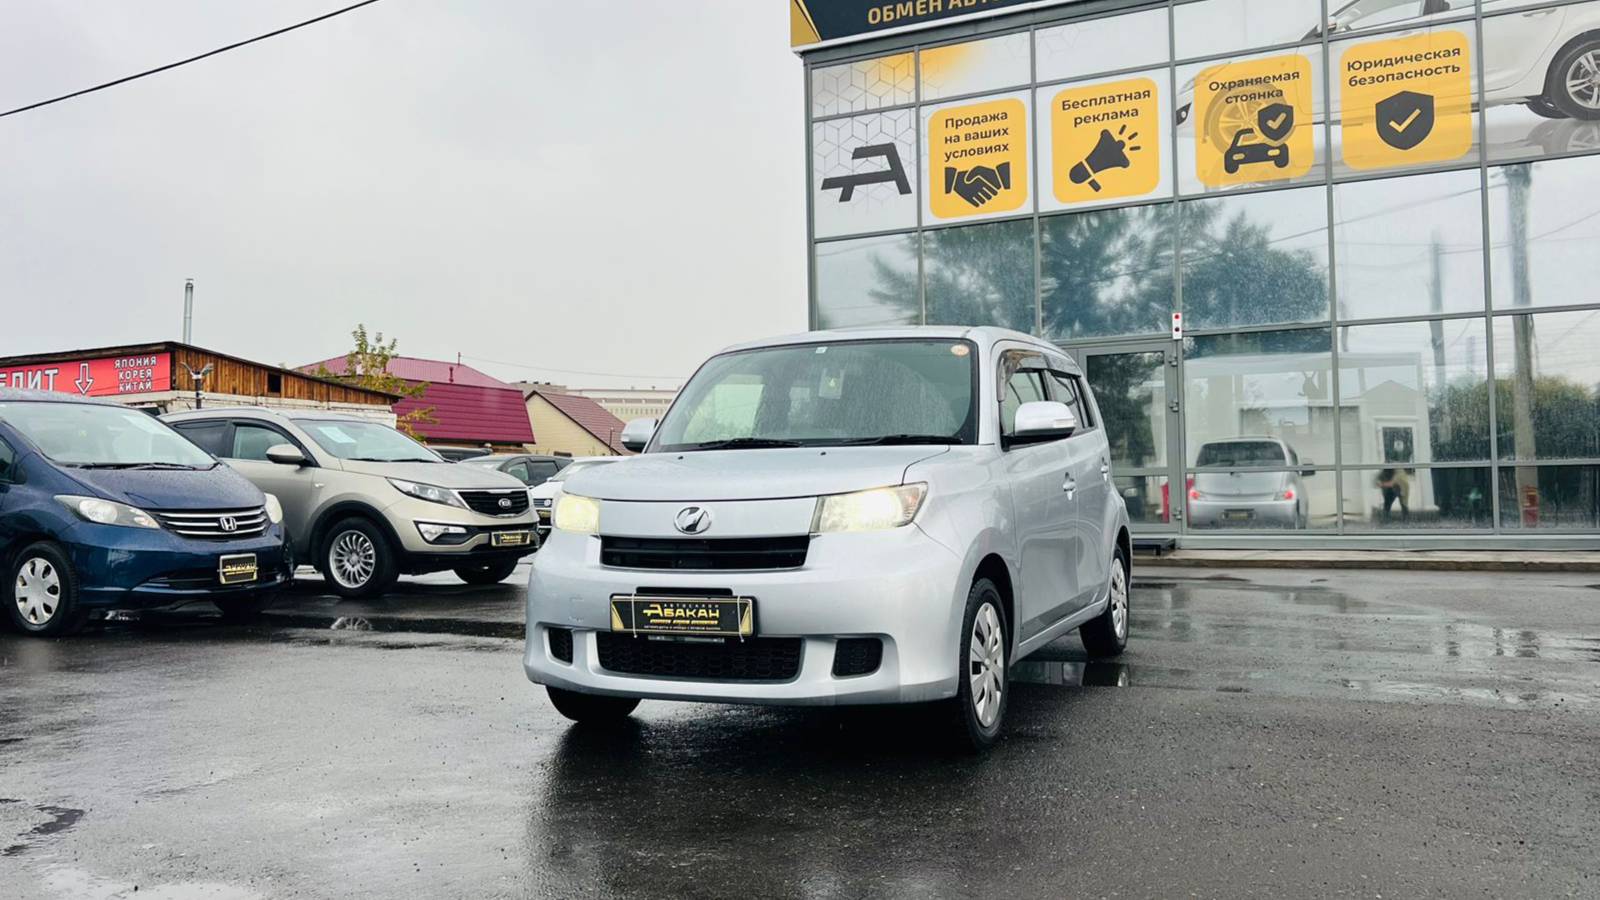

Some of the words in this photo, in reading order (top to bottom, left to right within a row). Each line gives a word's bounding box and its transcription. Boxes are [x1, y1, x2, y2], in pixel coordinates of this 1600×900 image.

[868, 0, 942, 24] ОБМЕН
[1346, 46, 1461, 73] Юридическая
[1208, 70, 1301, 93] Охраняемая
[1348, 62, 1461, 87] безопасность
[1061, 87, 1151, 112] Бесплатная
[1225, 88, 1283, 106] стоянка
[944, 109, 1009, 130] Продажа
[1073, 109, 1139, 129] реклама
[944, 134, 961, 145] на
[964, 127, 1009, 142] ваших
[944, 144, 1010, 163] условиях
[114, 356, 157, 369] ЯПОНИЯ
[118, 369, 153, 381] КОРЕЯ
[118, 380, 152, 393] КИТАЙ
